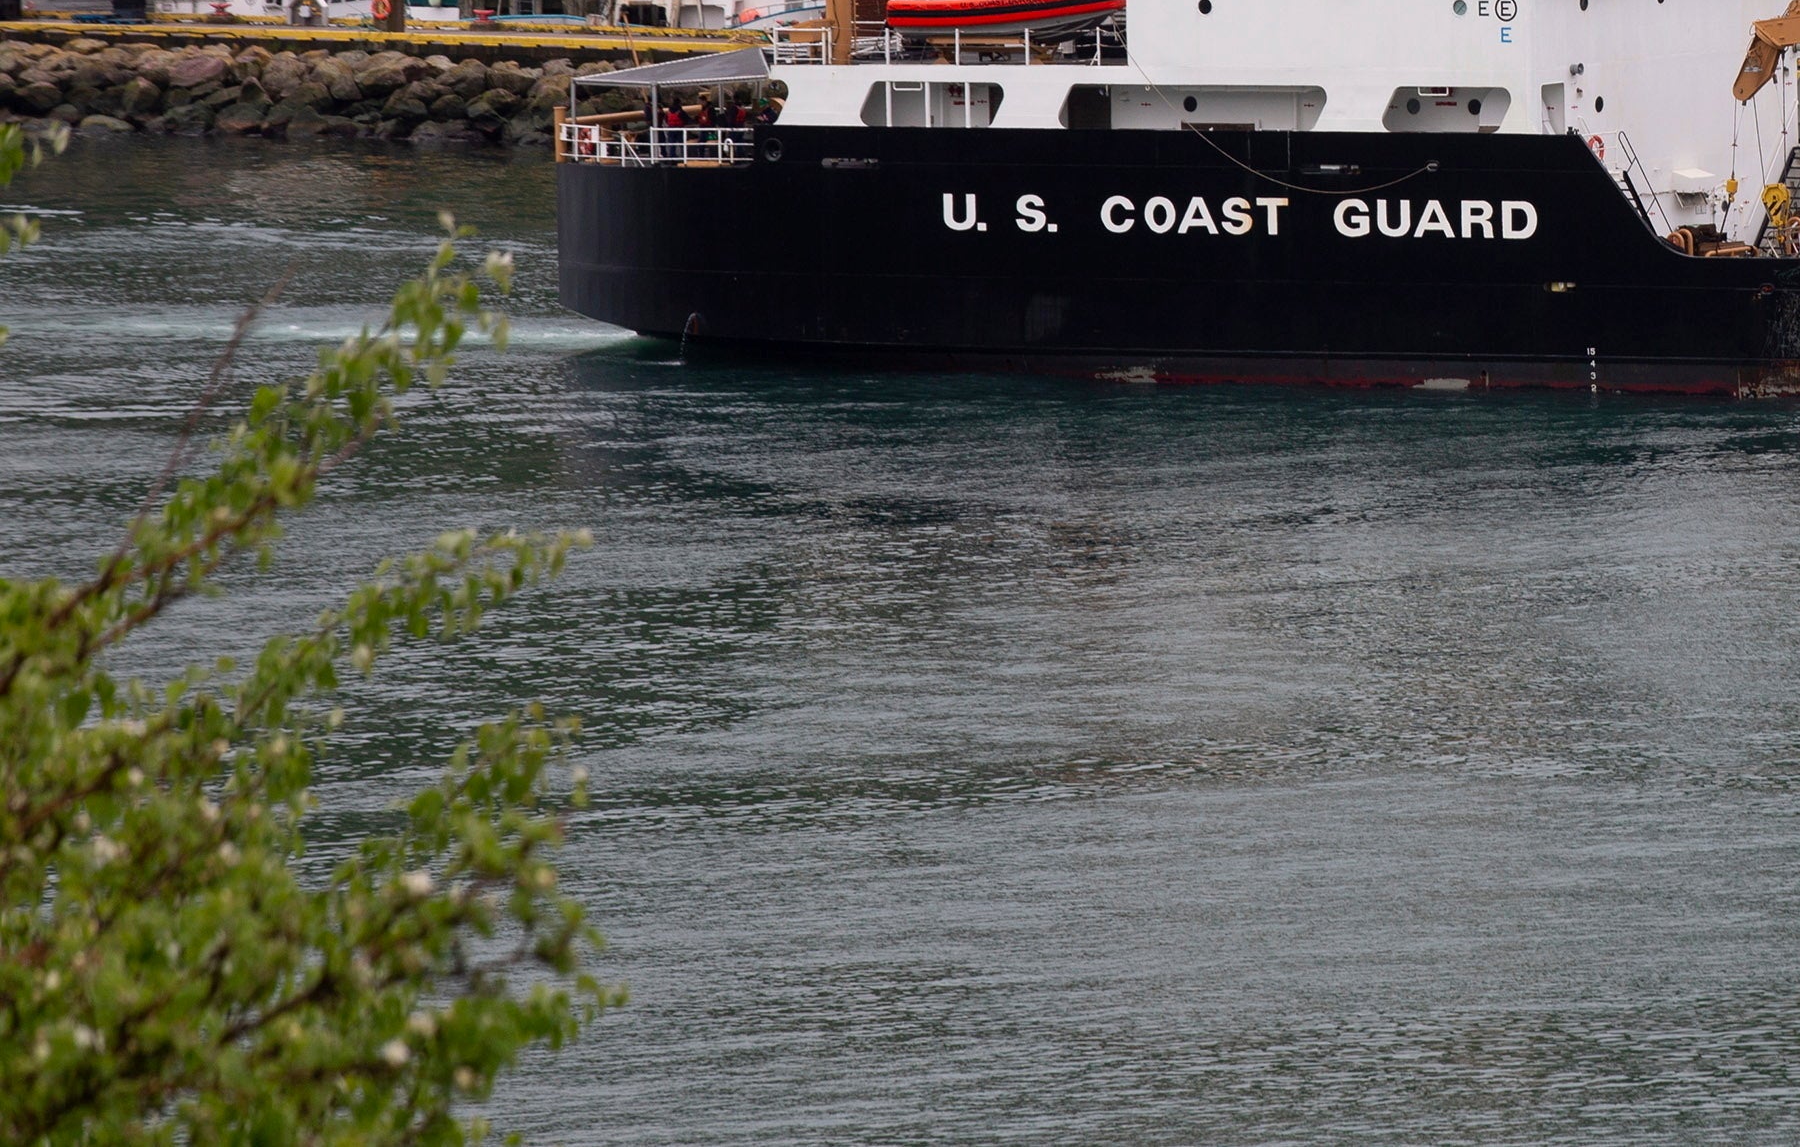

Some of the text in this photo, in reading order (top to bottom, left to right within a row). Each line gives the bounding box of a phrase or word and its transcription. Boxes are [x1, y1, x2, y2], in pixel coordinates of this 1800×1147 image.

[1478, 0, 1512, 16] E E
[1501, 27, 1512, 42] E
[942, 192, 1538, 240] U. S. COAST GUARD
[1586, 347, 1596, 356] 15
[1590, 359, 1596, 368] 4
[1590, 371, 1596, 380] 3
[1590, 384, 1597, 393] 2
